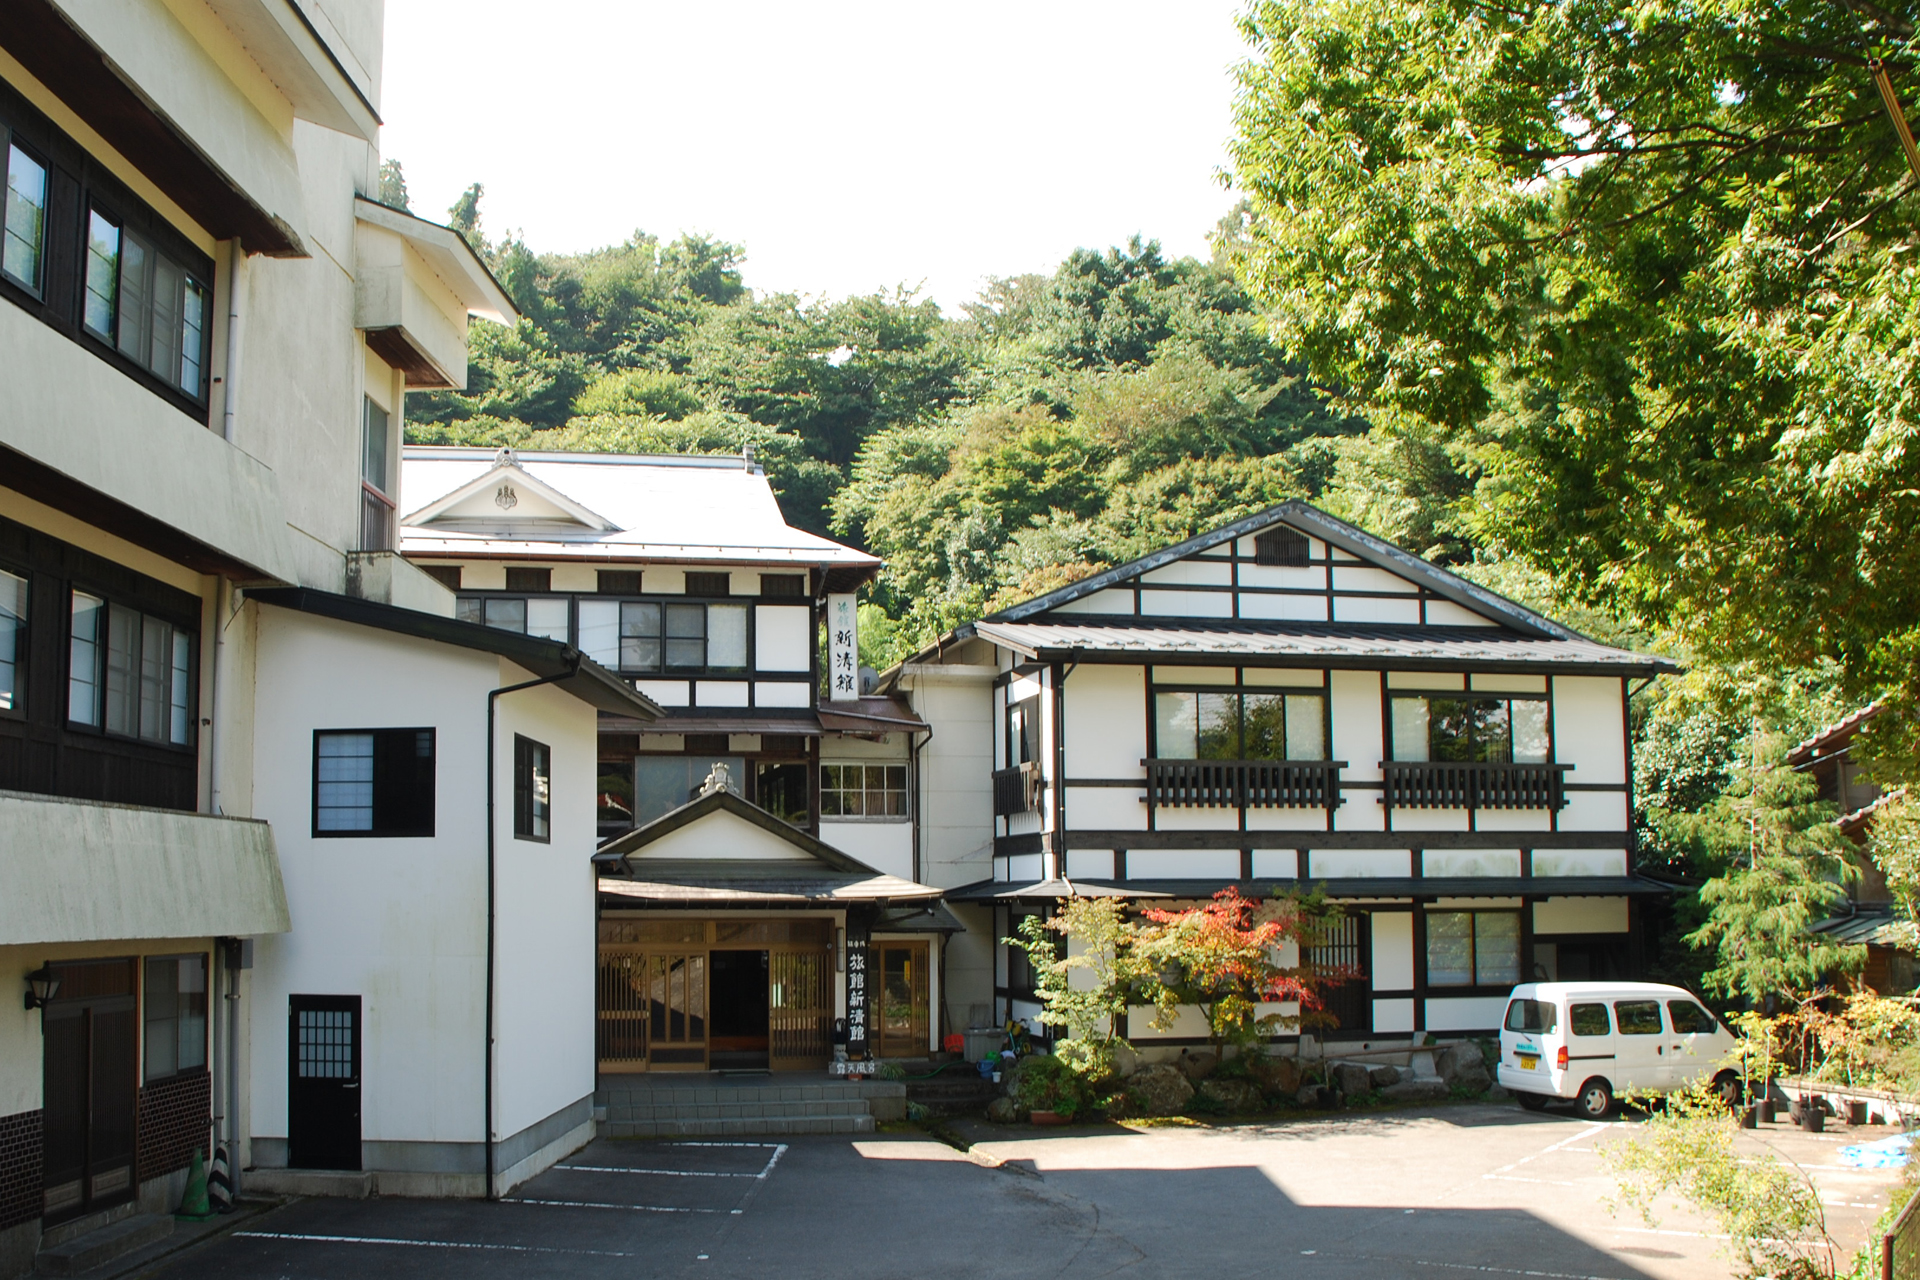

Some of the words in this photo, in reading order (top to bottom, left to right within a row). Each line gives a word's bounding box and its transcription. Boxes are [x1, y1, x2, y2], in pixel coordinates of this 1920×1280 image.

[849, 953, 866, 1042] 旅館新清館
